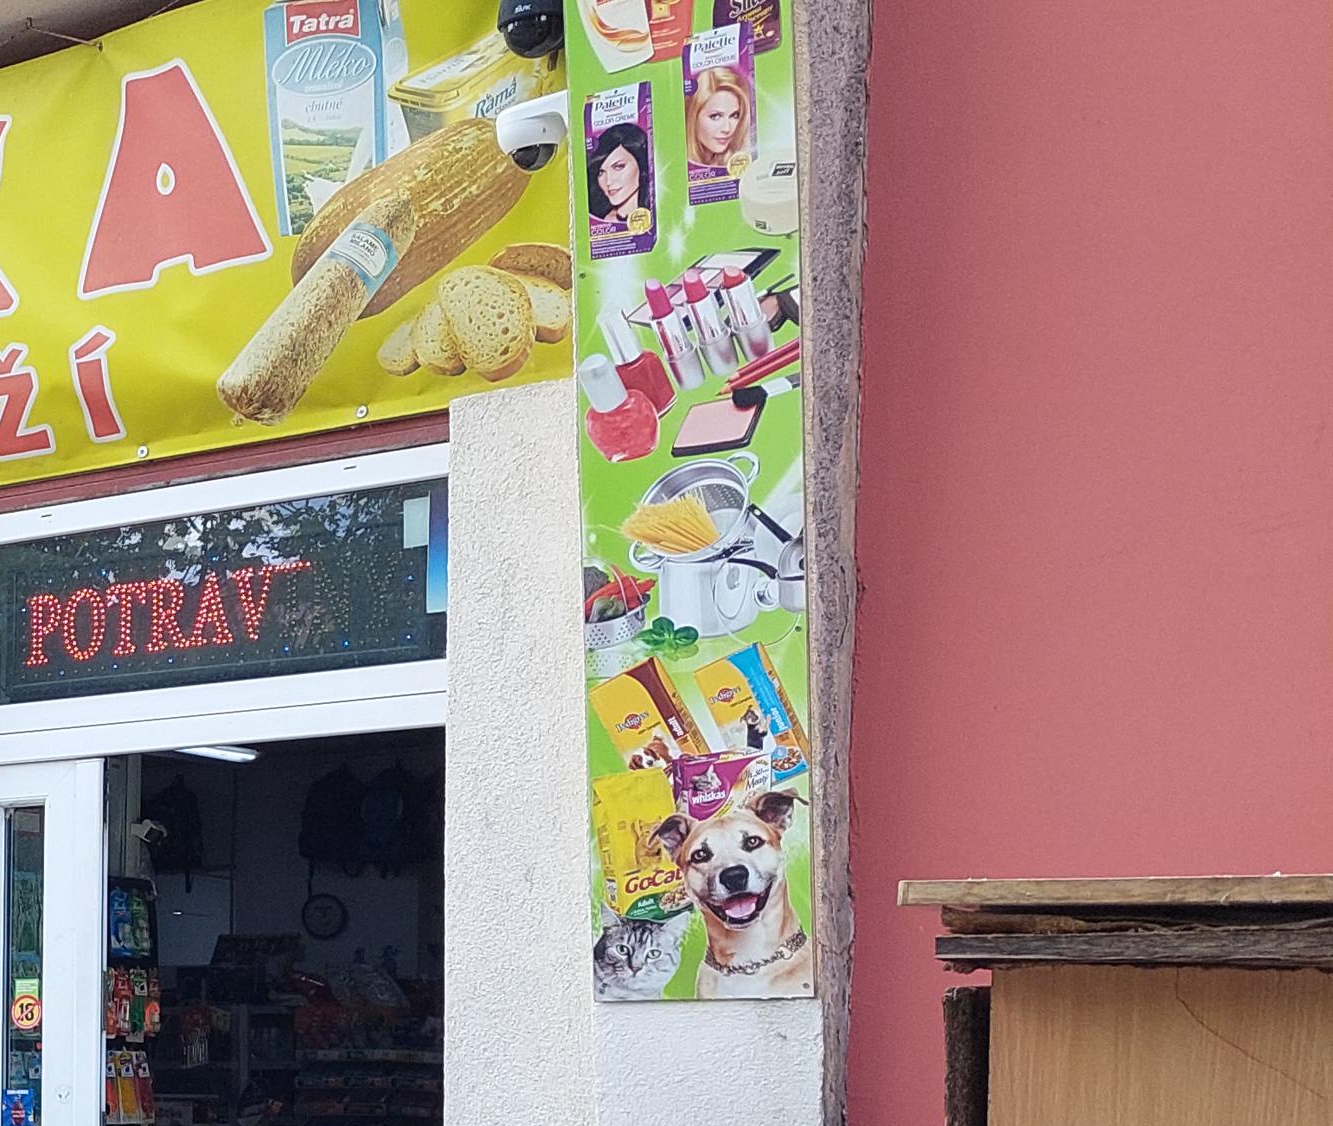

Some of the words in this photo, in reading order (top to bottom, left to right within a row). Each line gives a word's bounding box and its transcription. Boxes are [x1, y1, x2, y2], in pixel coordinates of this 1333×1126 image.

[289, 9, 356, 35] Tatra
[694, 36, 736, 53] Palette
[278, 43, 371, 85] Mléko
[475, 76, 517, 118] Rama
[595, 95, 636, 112] Palette
[692, 790, 726, 805] whiskas
